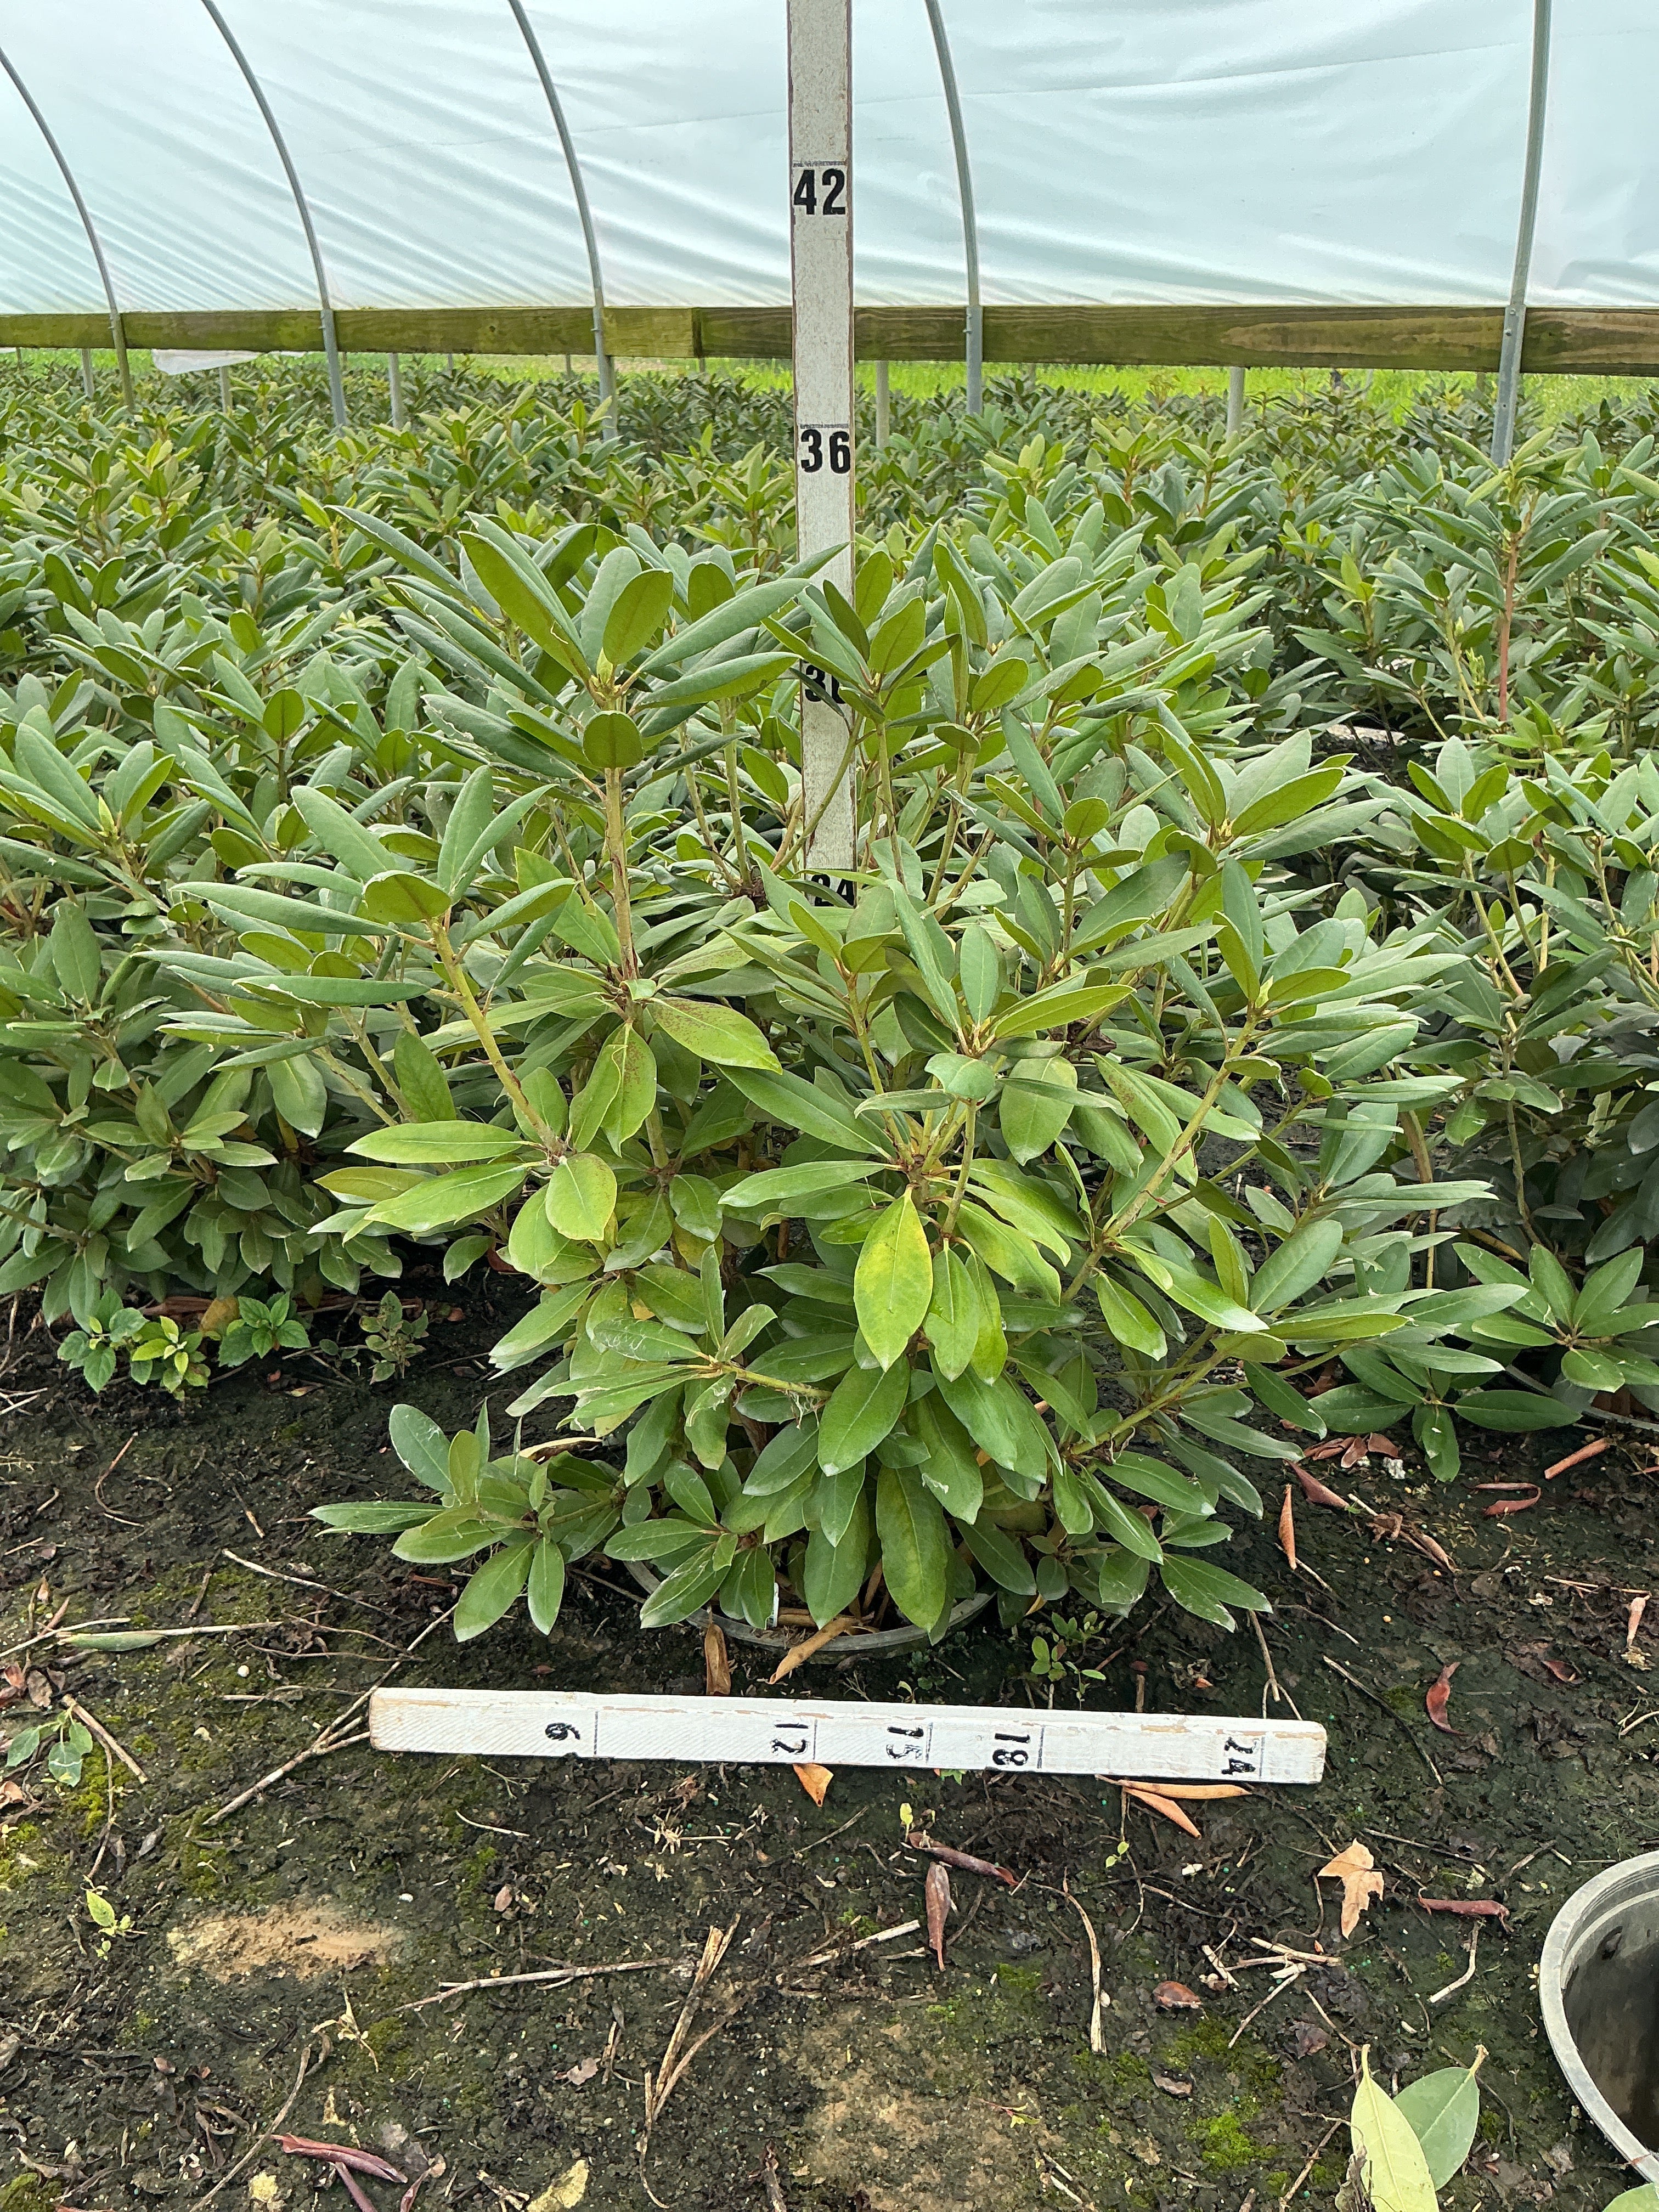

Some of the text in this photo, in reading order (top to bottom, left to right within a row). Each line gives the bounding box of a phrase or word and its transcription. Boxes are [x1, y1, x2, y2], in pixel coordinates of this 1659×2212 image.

[793, 168, 846, 215] 42
[800, 429, 851, 473] 36
[545, 1722, 580, 1741] 6
[770, 1722, 810, 1755] 12
[886, 1726, 923, 1759] 15
[992, 1733, 1030, 1765] 18
[1221, 1736, 1259, 1775] 24
